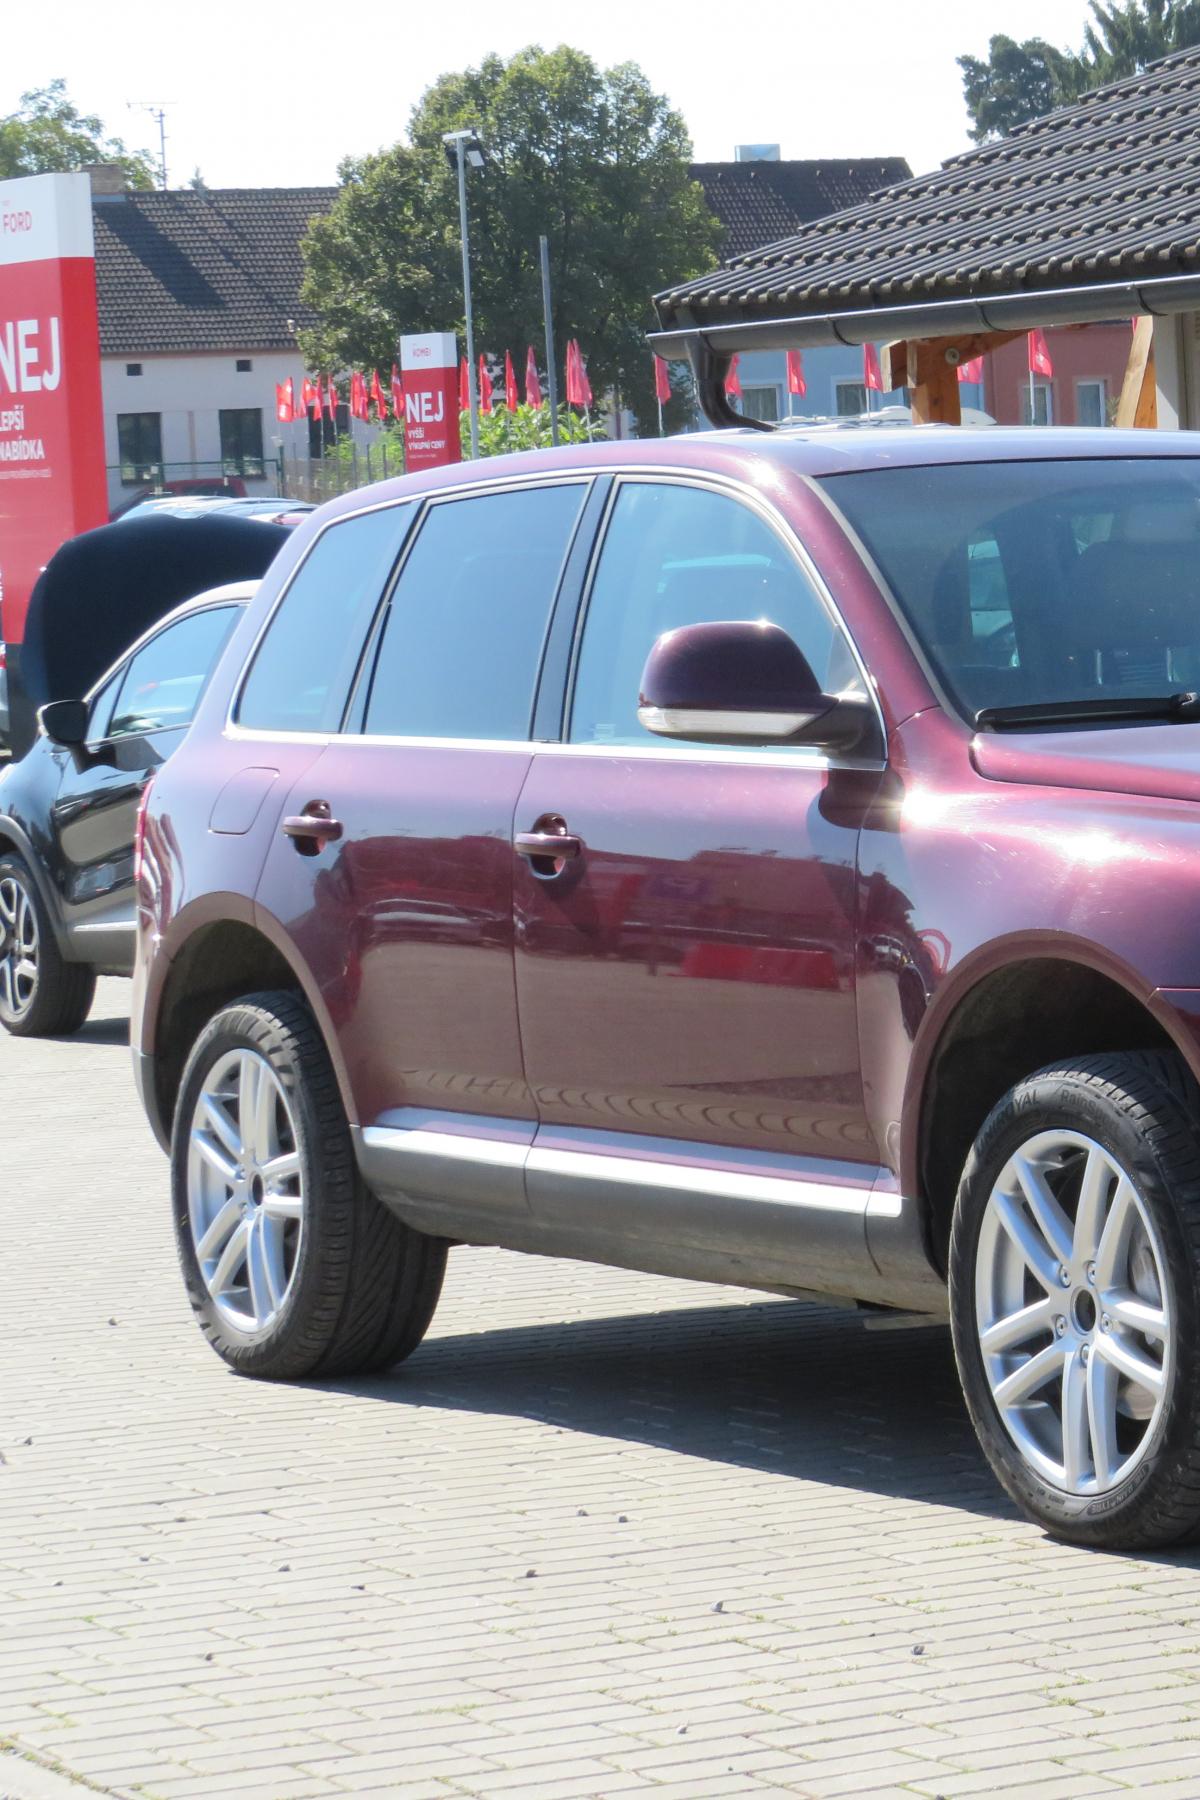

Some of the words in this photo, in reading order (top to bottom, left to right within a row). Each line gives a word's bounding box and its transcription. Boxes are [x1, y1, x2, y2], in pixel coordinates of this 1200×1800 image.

[3, 211, 33, 233] FORD
[0, 316, 62, 393] NEJ
[405, 391, 445, 423] NEJ
